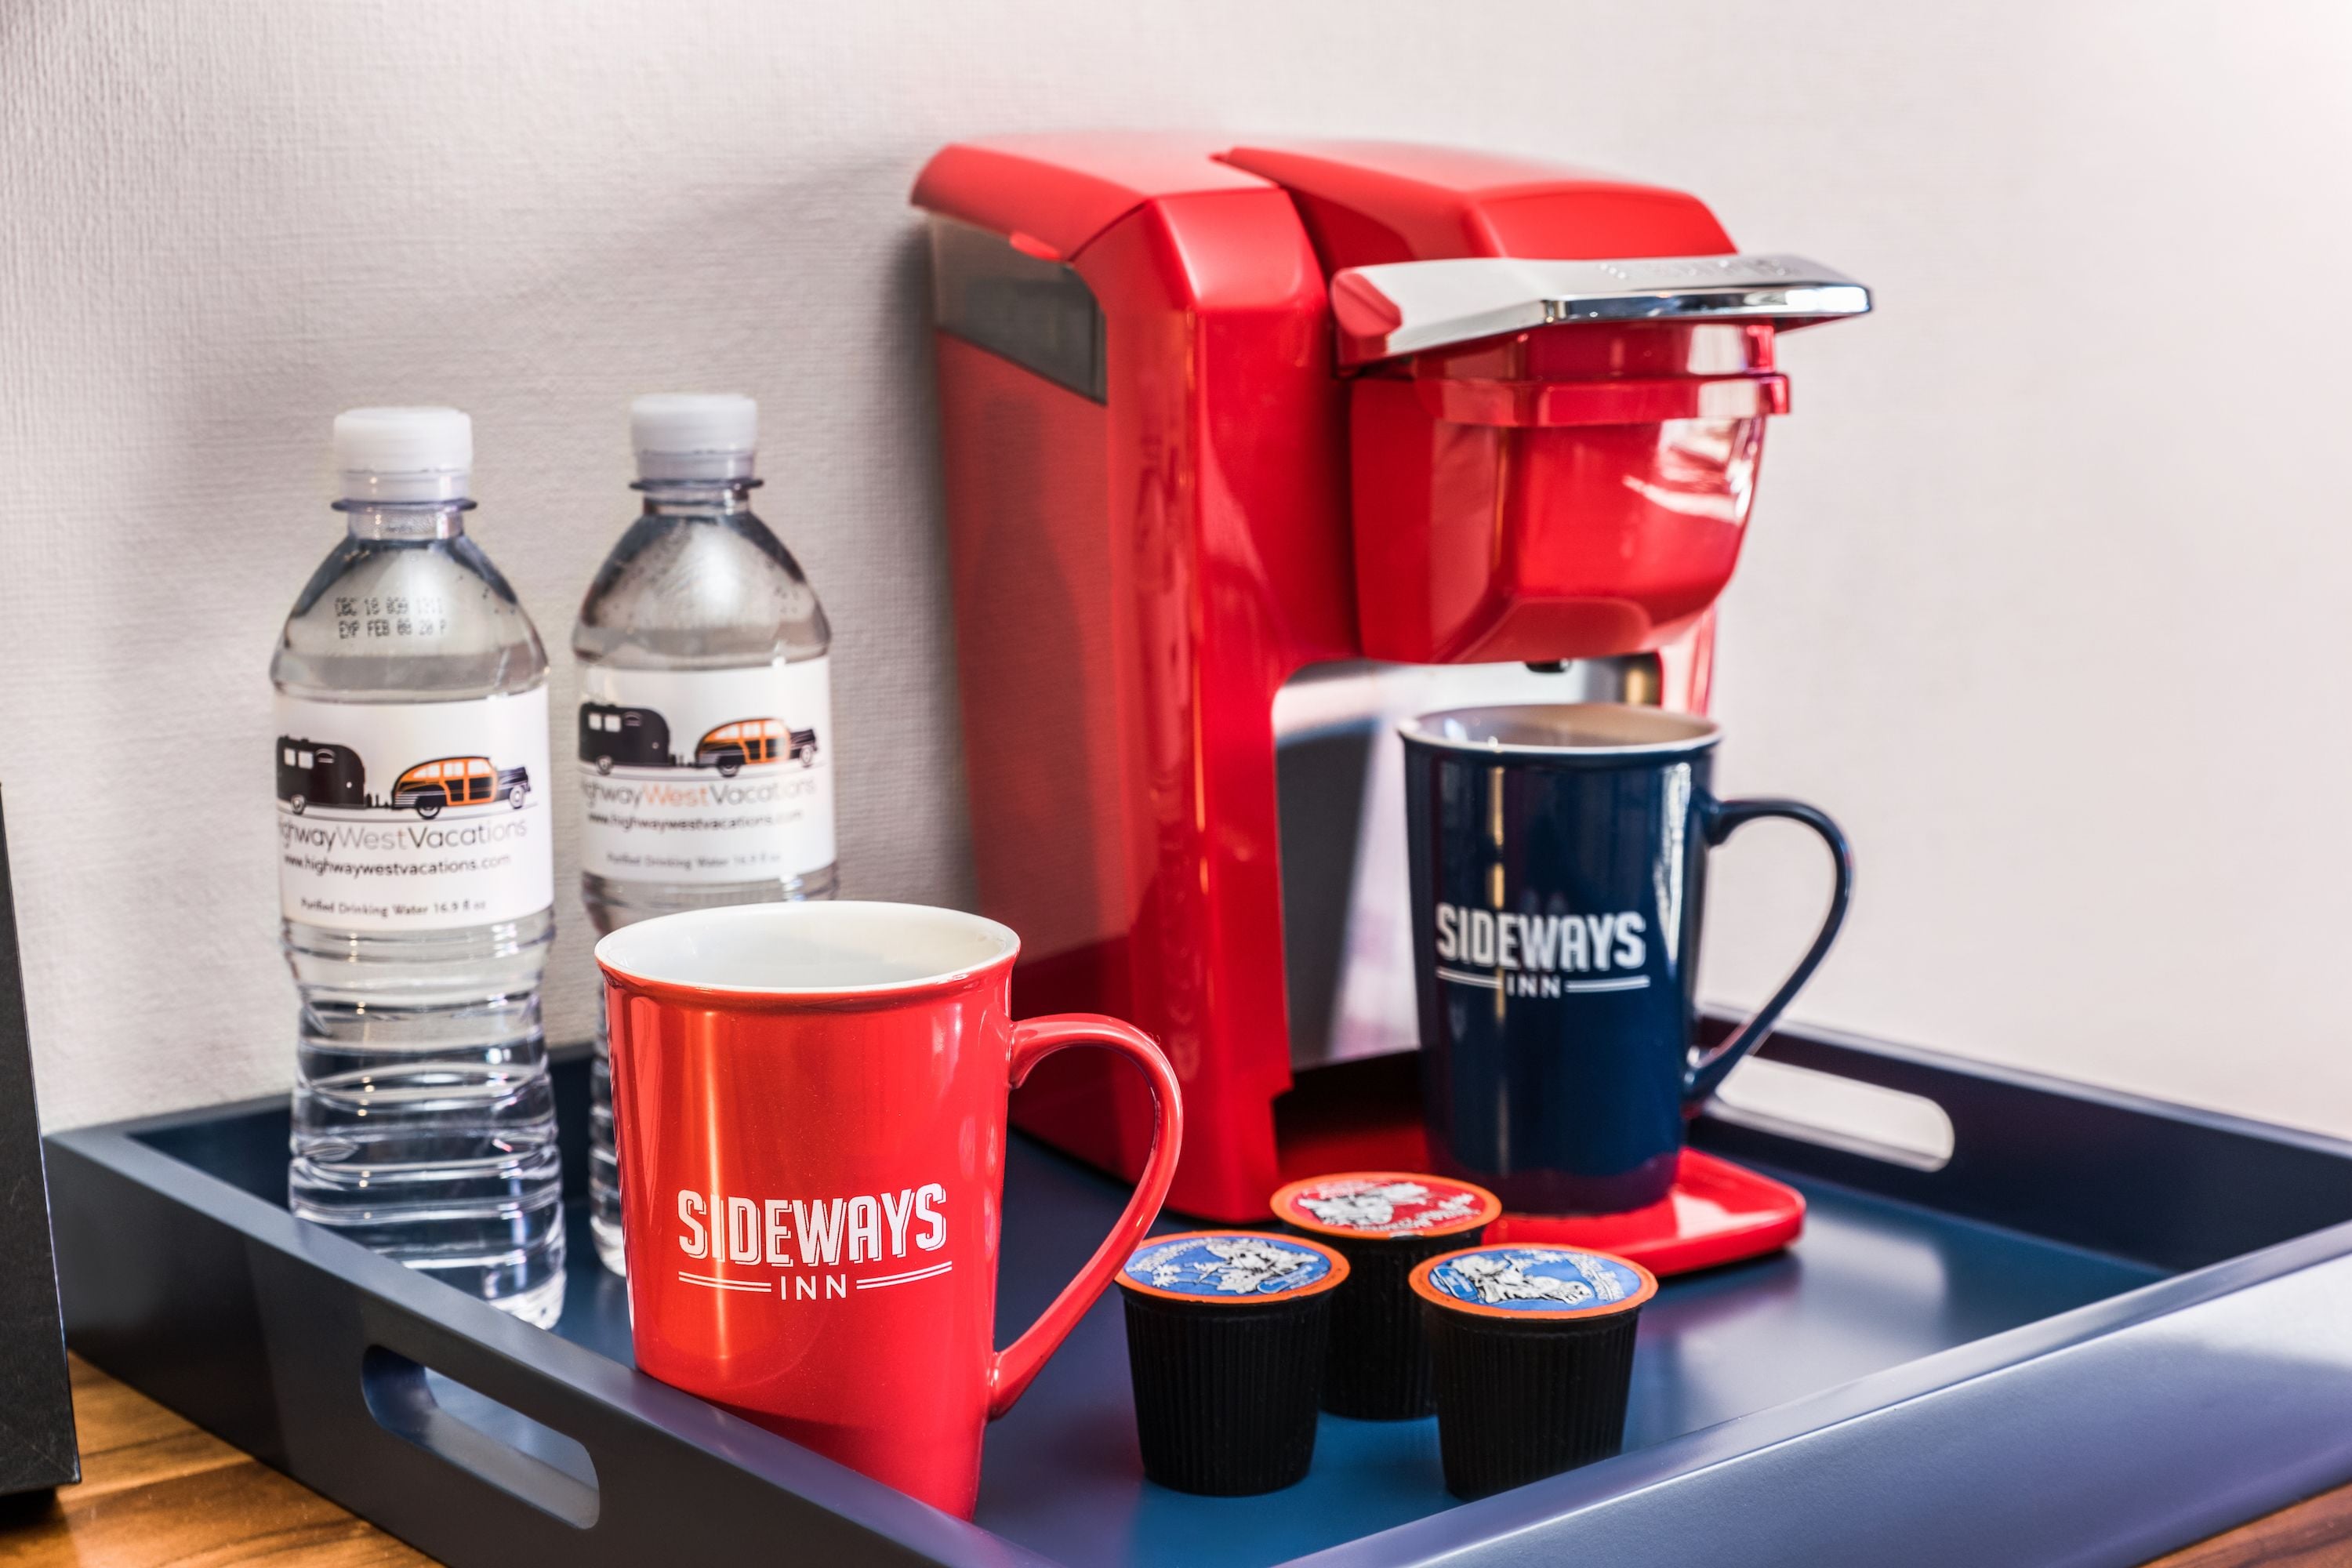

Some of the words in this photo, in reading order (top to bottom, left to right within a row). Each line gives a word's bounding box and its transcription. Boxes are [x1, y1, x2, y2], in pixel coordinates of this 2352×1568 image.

[338, 619, 361, 639] EXP
[366, 619, 390, 638] FEB
[338, 901, 388, 919] Drinking
[391, 903, 429, 916] Water
[1436, 902, 1646, 972] SIDEWAYS
[1506, 975, 1562, 999] INN
[677, 1182, 947, 1268] SIDEWAYS
[780, 1273, 847, 1301] INN
